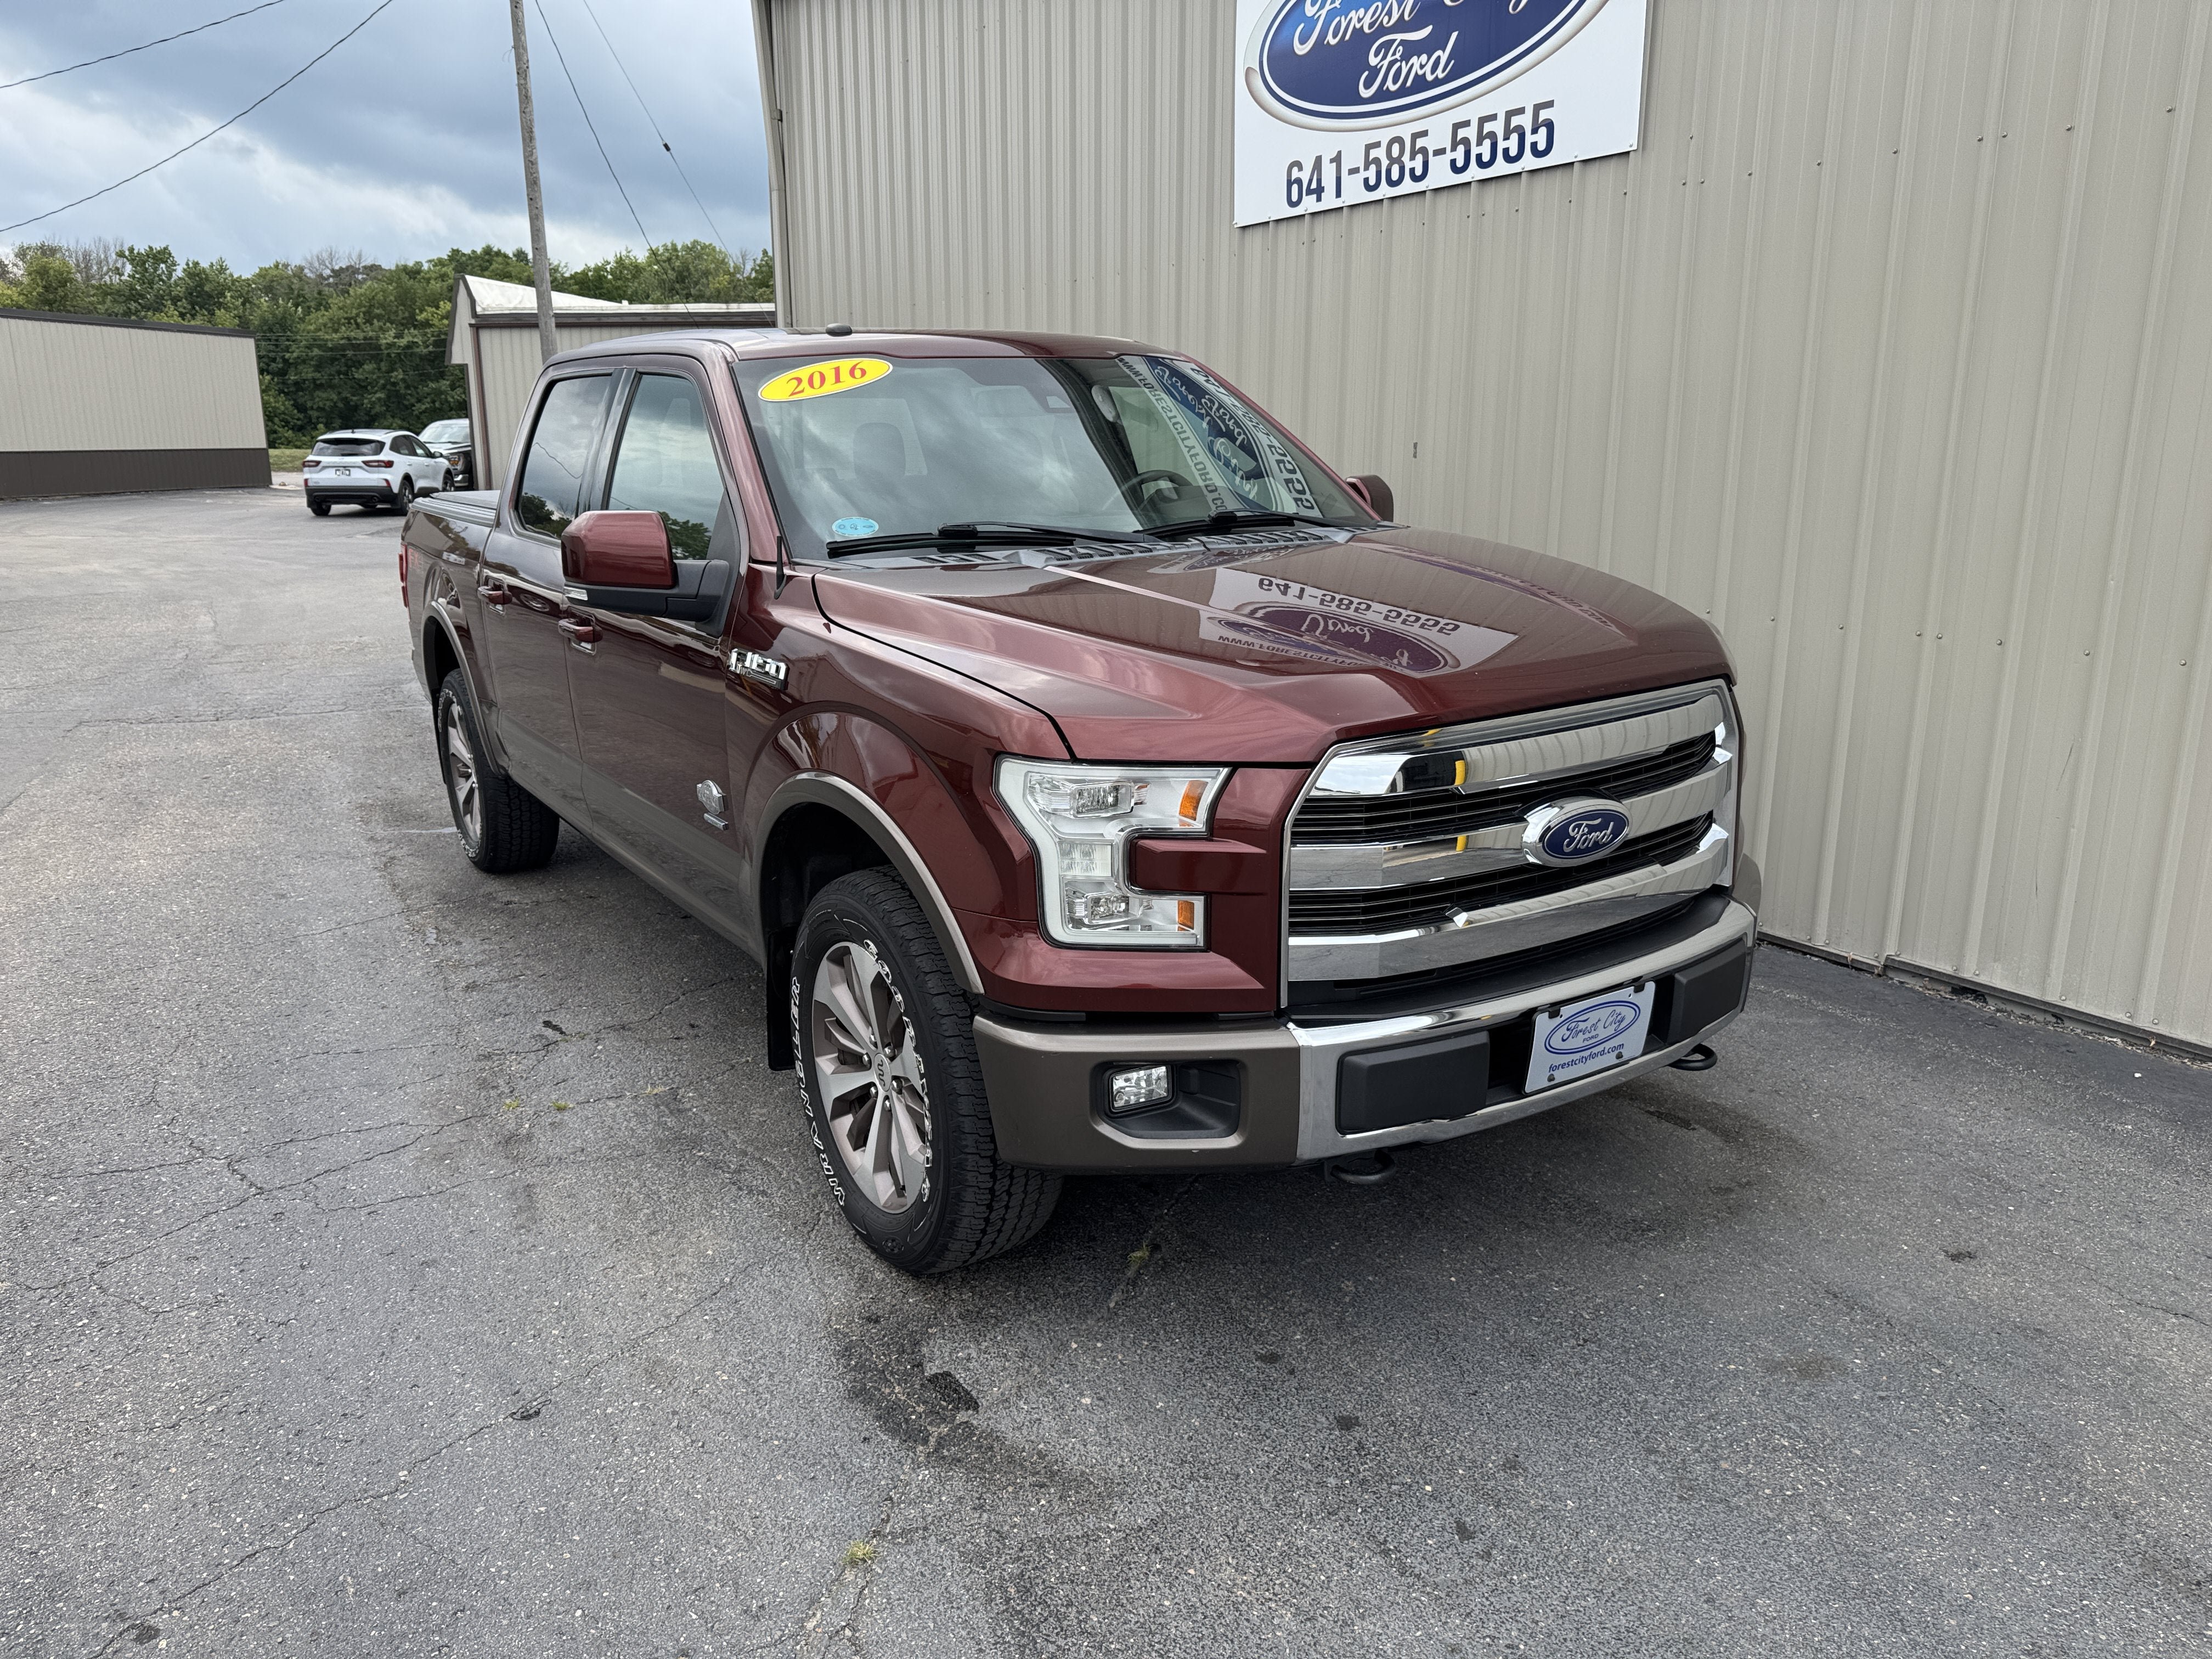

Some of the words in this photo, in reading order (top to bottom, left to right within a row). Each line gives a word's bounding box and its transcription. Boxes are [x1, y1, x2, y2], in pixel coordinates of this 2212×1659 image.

[1358, 25, 1459, 98] Ford
[1286, 99, 1555, 208] 641-585-5555
[786, 360, 867, 397] 2016
[1563, 817, 1614, 853] Ford
[1561, 1017, 1601, 1042] Forest
[1603, 1009, 1626, 1032] City
[1582, 1033, 1599, 1043] FORD
[1548, 1042, 1624, 1073] forestcityford.com
[791, 977, 845, 1206] WRANGLER
